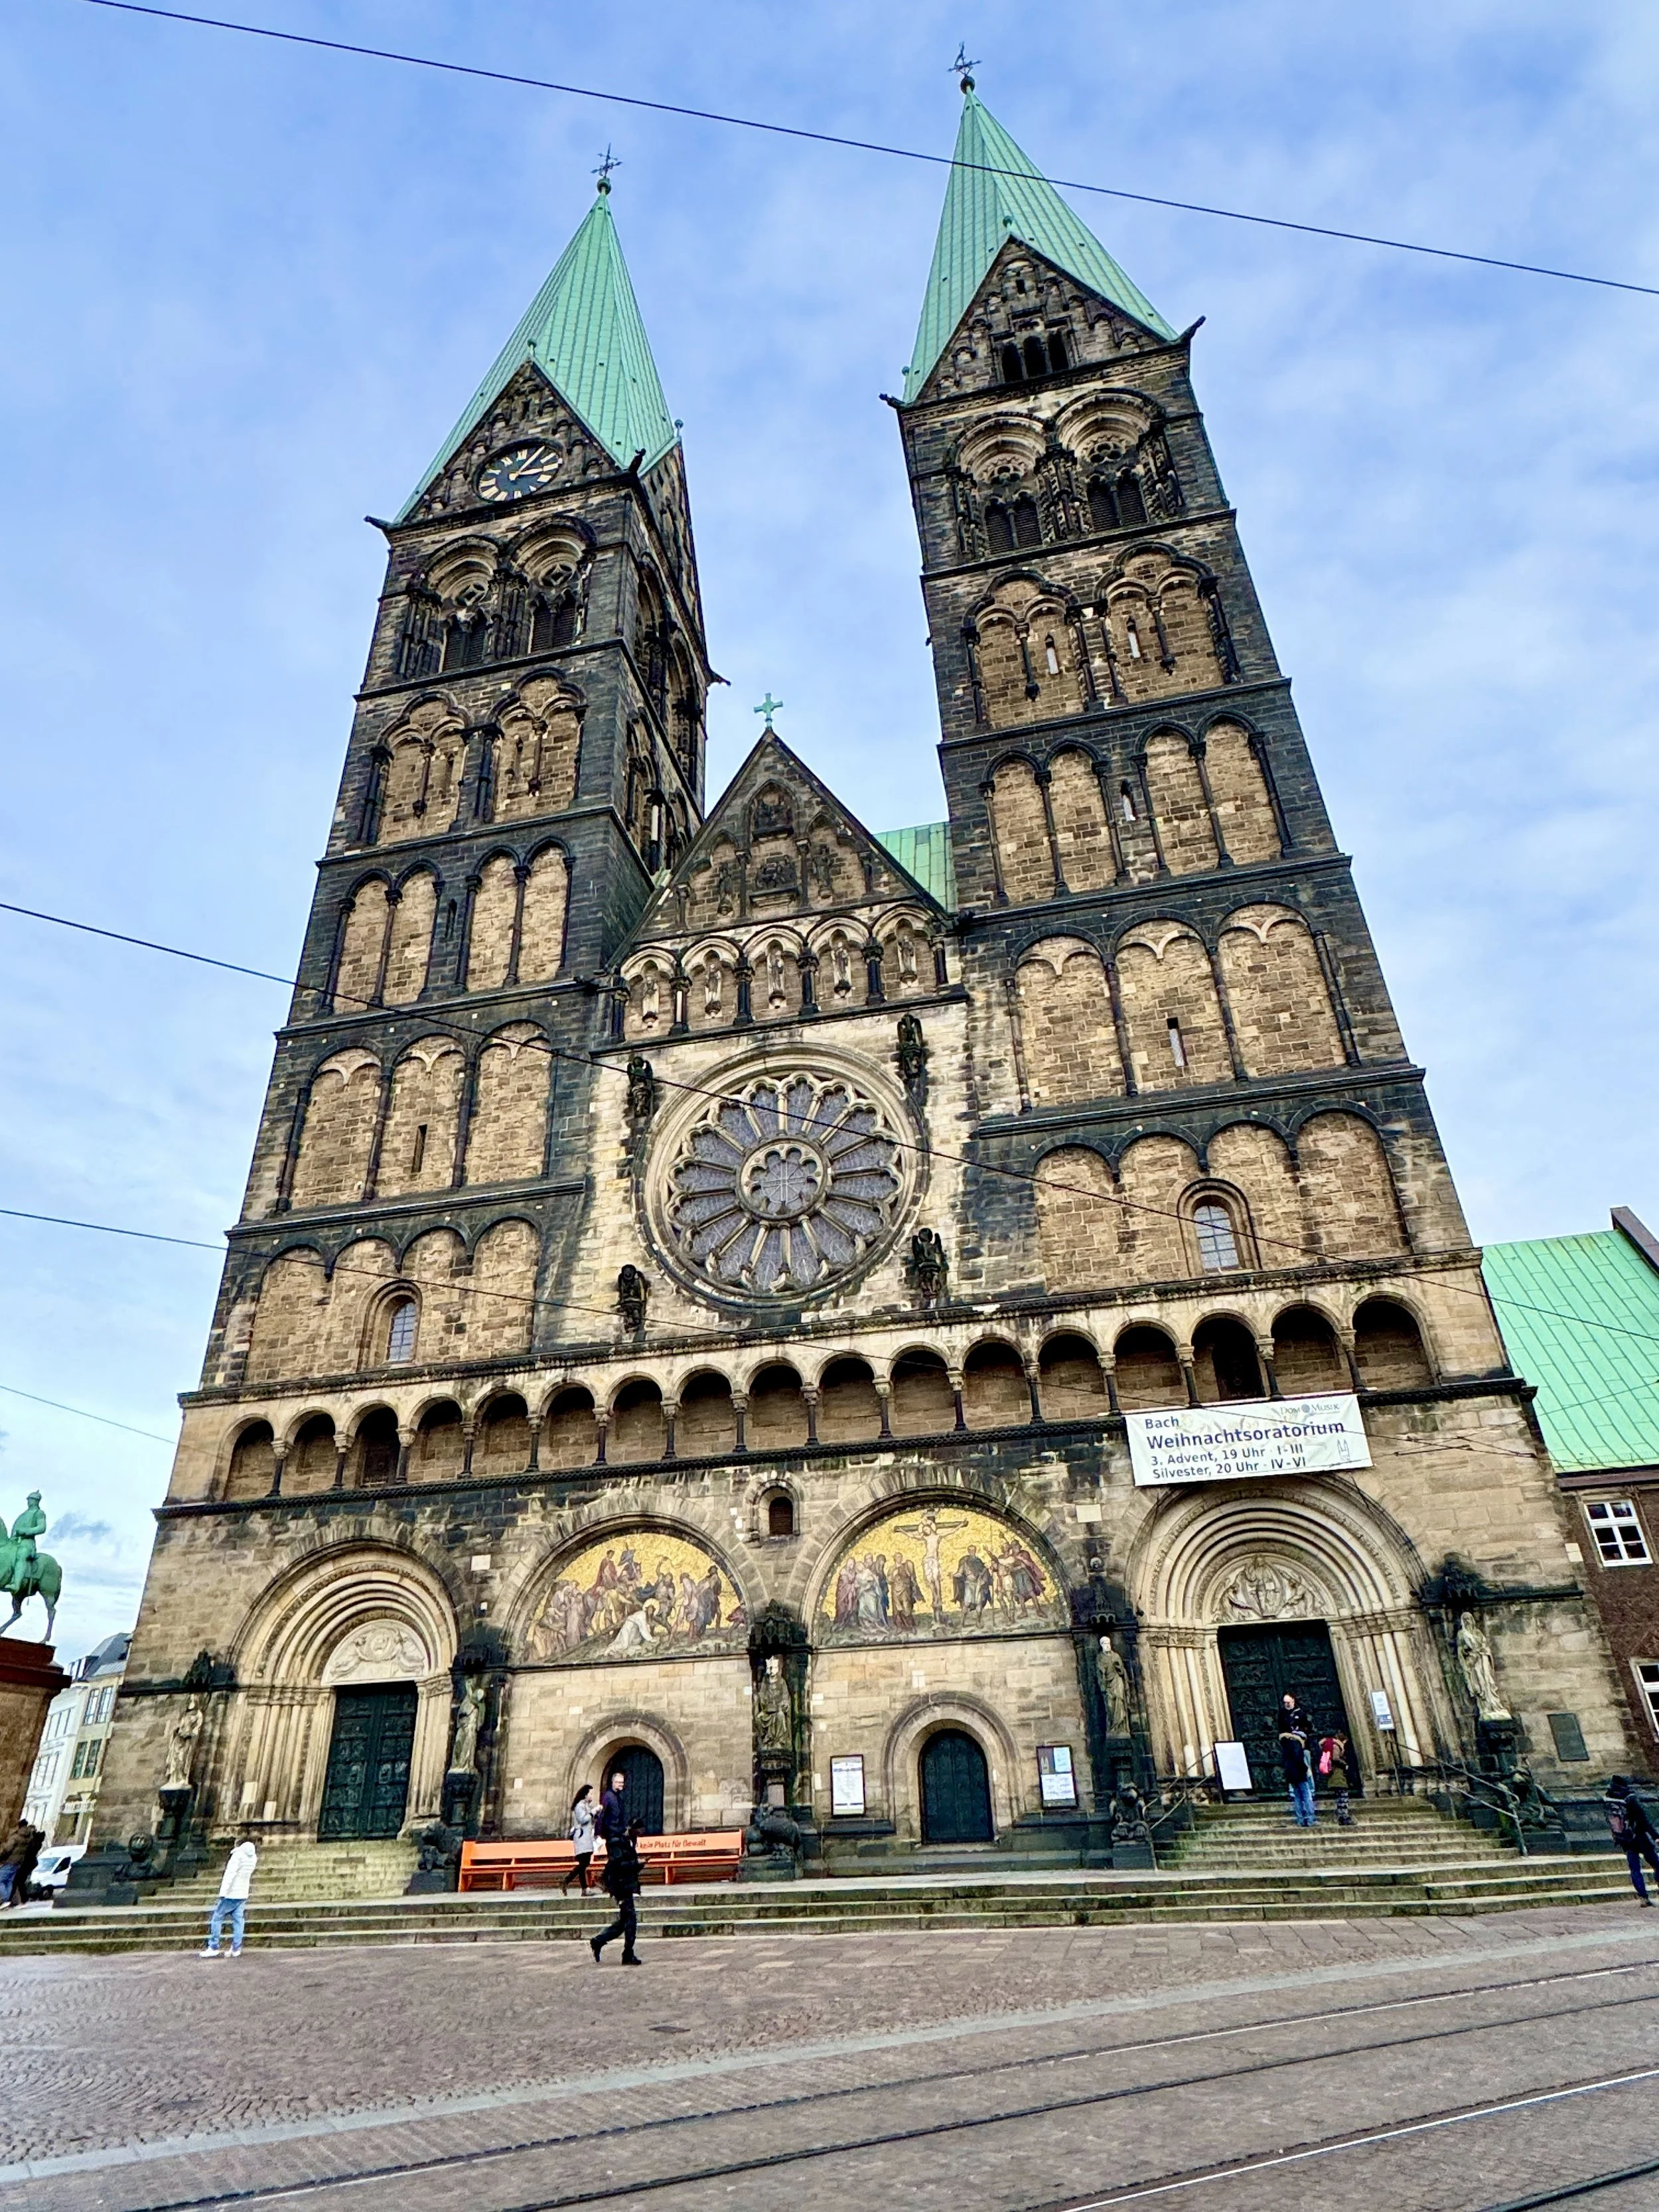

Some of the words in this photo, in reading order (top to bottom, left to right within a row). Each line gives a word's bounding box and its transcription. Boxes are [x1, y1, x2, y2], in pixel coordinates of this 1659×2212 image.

[1145, 1416, 1179, 1430] Bach
[1146, 1421, 1344, 1449] Weihnachtsoratorium
[1151, 1456, 1163, 1466] 3.
[1167, 1451, 1218, 1465] Advent,
[1222, 1449, 1238, 1460] 19
[1242, 1447, 1266, 1458] Uhr
[1153, 1466, 1212, 1479] Silvester,
[1215, 1463, 1232, 1474] 20
[1236, 1462, 1259, 1472] Uhr
